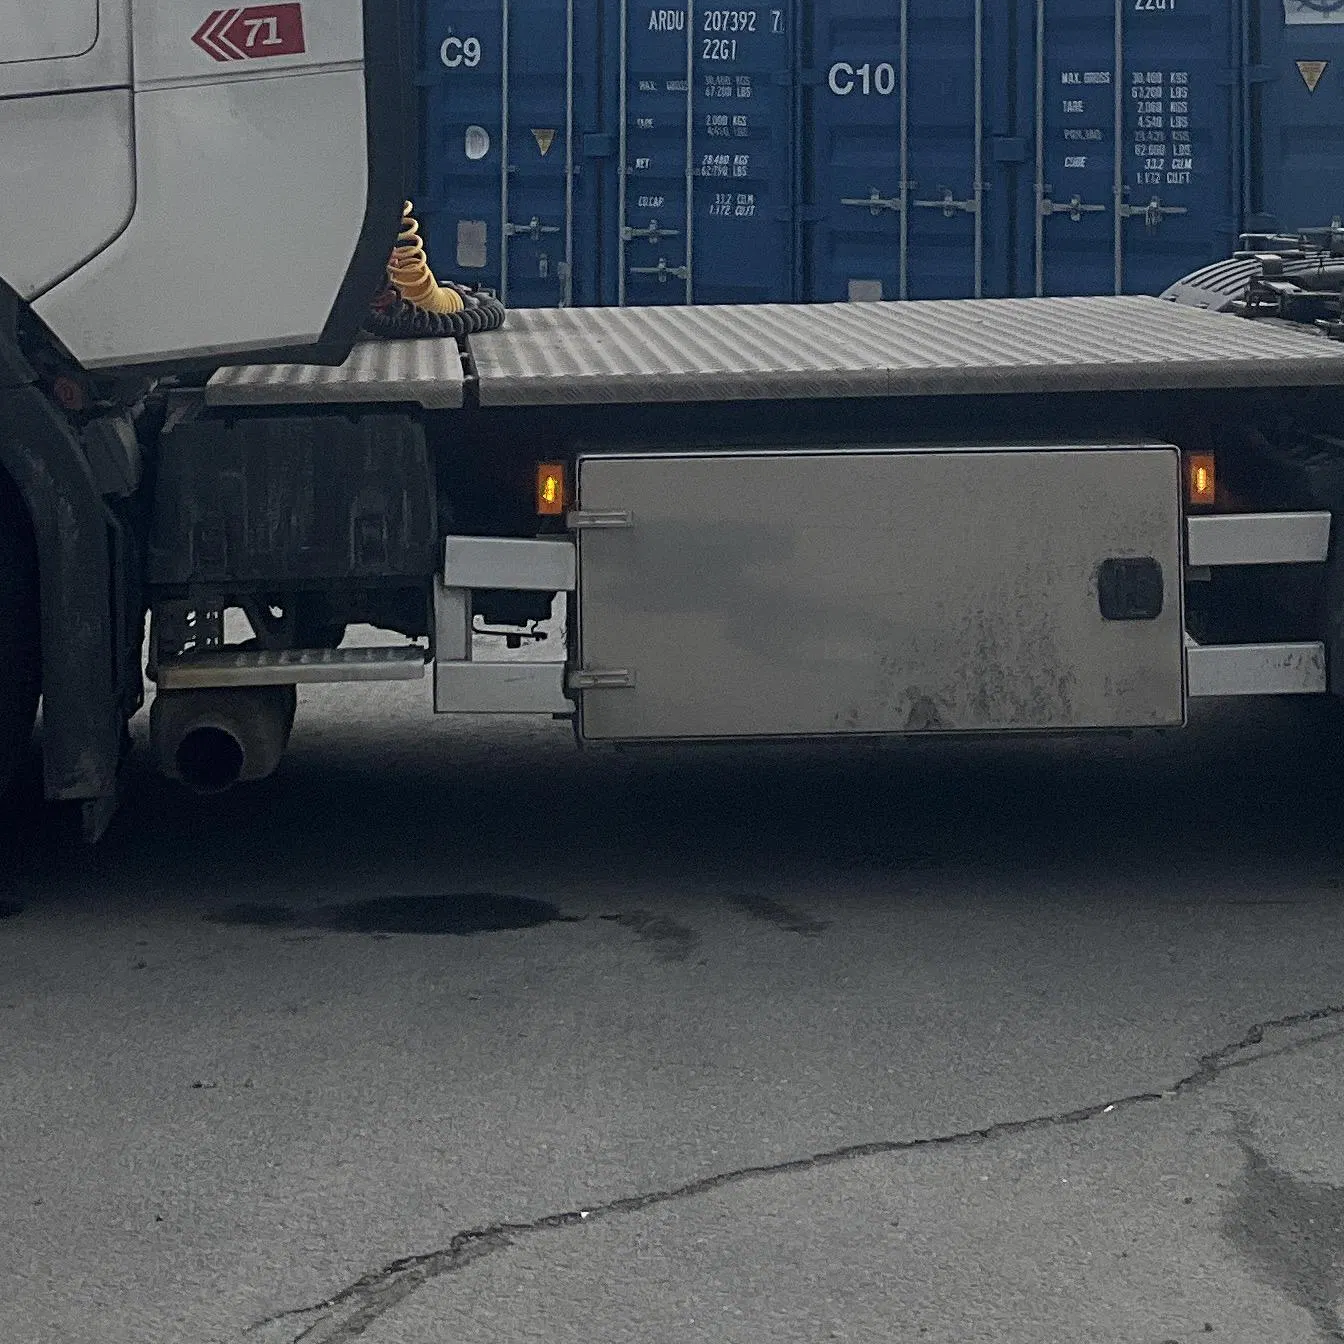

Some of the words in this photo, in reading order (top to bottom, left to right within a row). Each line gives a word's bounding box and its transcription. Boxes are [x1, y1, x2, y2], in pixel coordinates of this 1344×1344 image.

[244, 16, 283, 47] 71
[648, 10, 684, 31] ARDU
[703, 11, 756, 31] 207392
[771, 10, 781, 33] 7
[440, 37, 481, 67] C9
[703, 39, 736, 60] 22G1
[828, 62, 895, 95] C10
